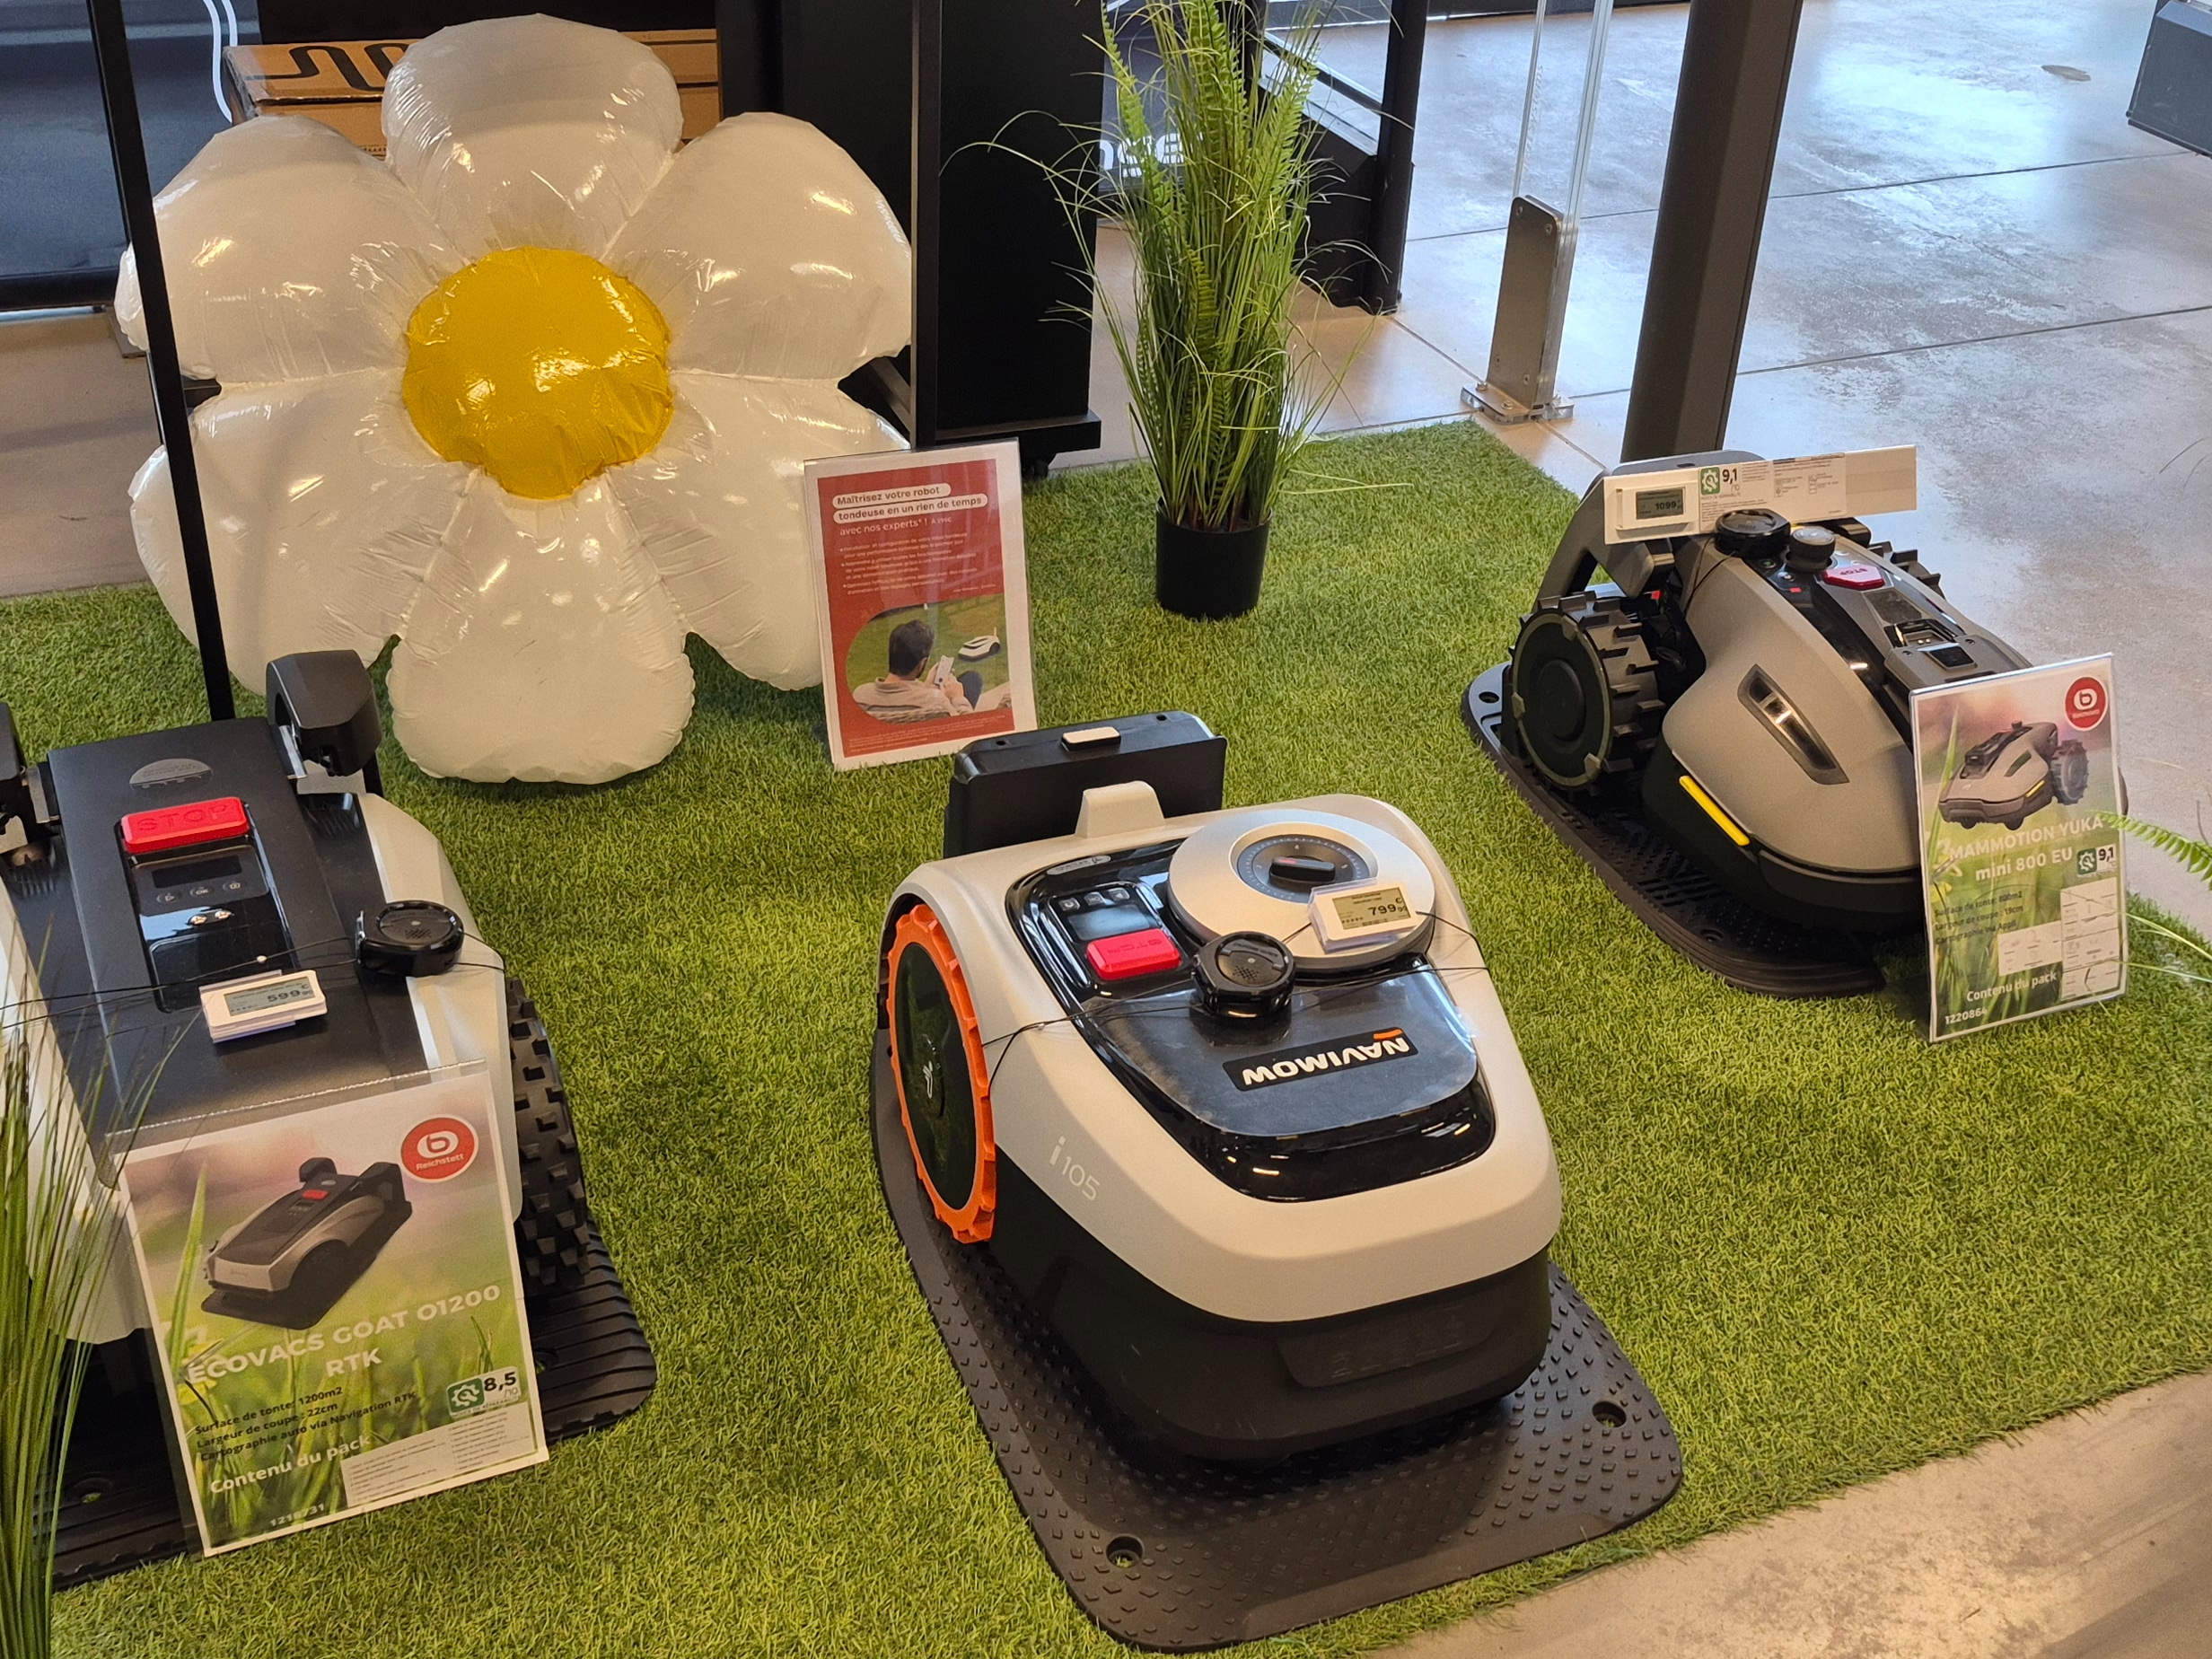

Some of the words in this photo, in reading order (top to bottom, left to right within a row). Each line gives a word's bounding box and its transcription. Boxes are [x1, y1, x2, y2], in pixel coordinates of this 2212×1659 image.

[1722, 468, 1737, 484] 9,1
[837, 495, 882, 505] Maîtrisez
[885, 490, 910, 500] votre
[913, 487, 940, 496] robot
[838, 509, 885, 521] tondeuse
[887, 505, 900, 515] en
[901, 505, 914, 514] un
[916, 502, 935, 512] rien
[936, 499, 949, 509] de
[951, 496, 982, 508] temps
[1655, 501, 1677, 511] 1099
[839, 526, 862, 536] avec
[864, 523, 881, 533] nos
[136, 803, 228, 831] STOP
[1951, 825, 2055, 861] MAMMOTION
[2058, 815, 2103, 837] YUKA
[1975, 860, 2012, 882] mini
[2015, 853, 2047, 872] 800
[2051, 847, 2073, 864] EU
[2098, 847, 2114, 862] 9,1
[1367, 903, 1397, 916] 799
[268, 989, 301, 1002] 599
[1966, 984, 2013, 1002] Contenu
[2014, 975, 2030, 989] du
[2032, 971, 2058, 988] pack
[1242, 1036, 1410, 1085] NAVIMOW
[416, 1153, 464, 1172] Reichstett
[188, 1332, 325, 1384] ECOVACS
[332, 1310, 408, 1345] GOAT
[325, 1347, 382, 1377] RTK
[483, 1371, 517, 1391] 8,5
[195, 1417, 241, 1435] Surface
[242, 1410, 257, 1421] de
[298, 1387, 343, 1406] 1200m2
[197, 1429, 243, 1449] Largeur
[246, 1424, 261, 1435] de
[263, 1415, 298, 1432] coupe
[307, 1402, 338, 1418] 22cm
[200, 1433, 277, 1462] Cartographie
[280, 1424, 308, 1440] auto
[310, 1418, 328, 1431] via
[329, 1399, 392, 1425] Navigation
[394, 1391, 417, 1404] RTK
[210, 1461, 293, 1495] Contenu
[296, 1451, 321, 1469] du
[326, 1434, 371, 1462] pack
